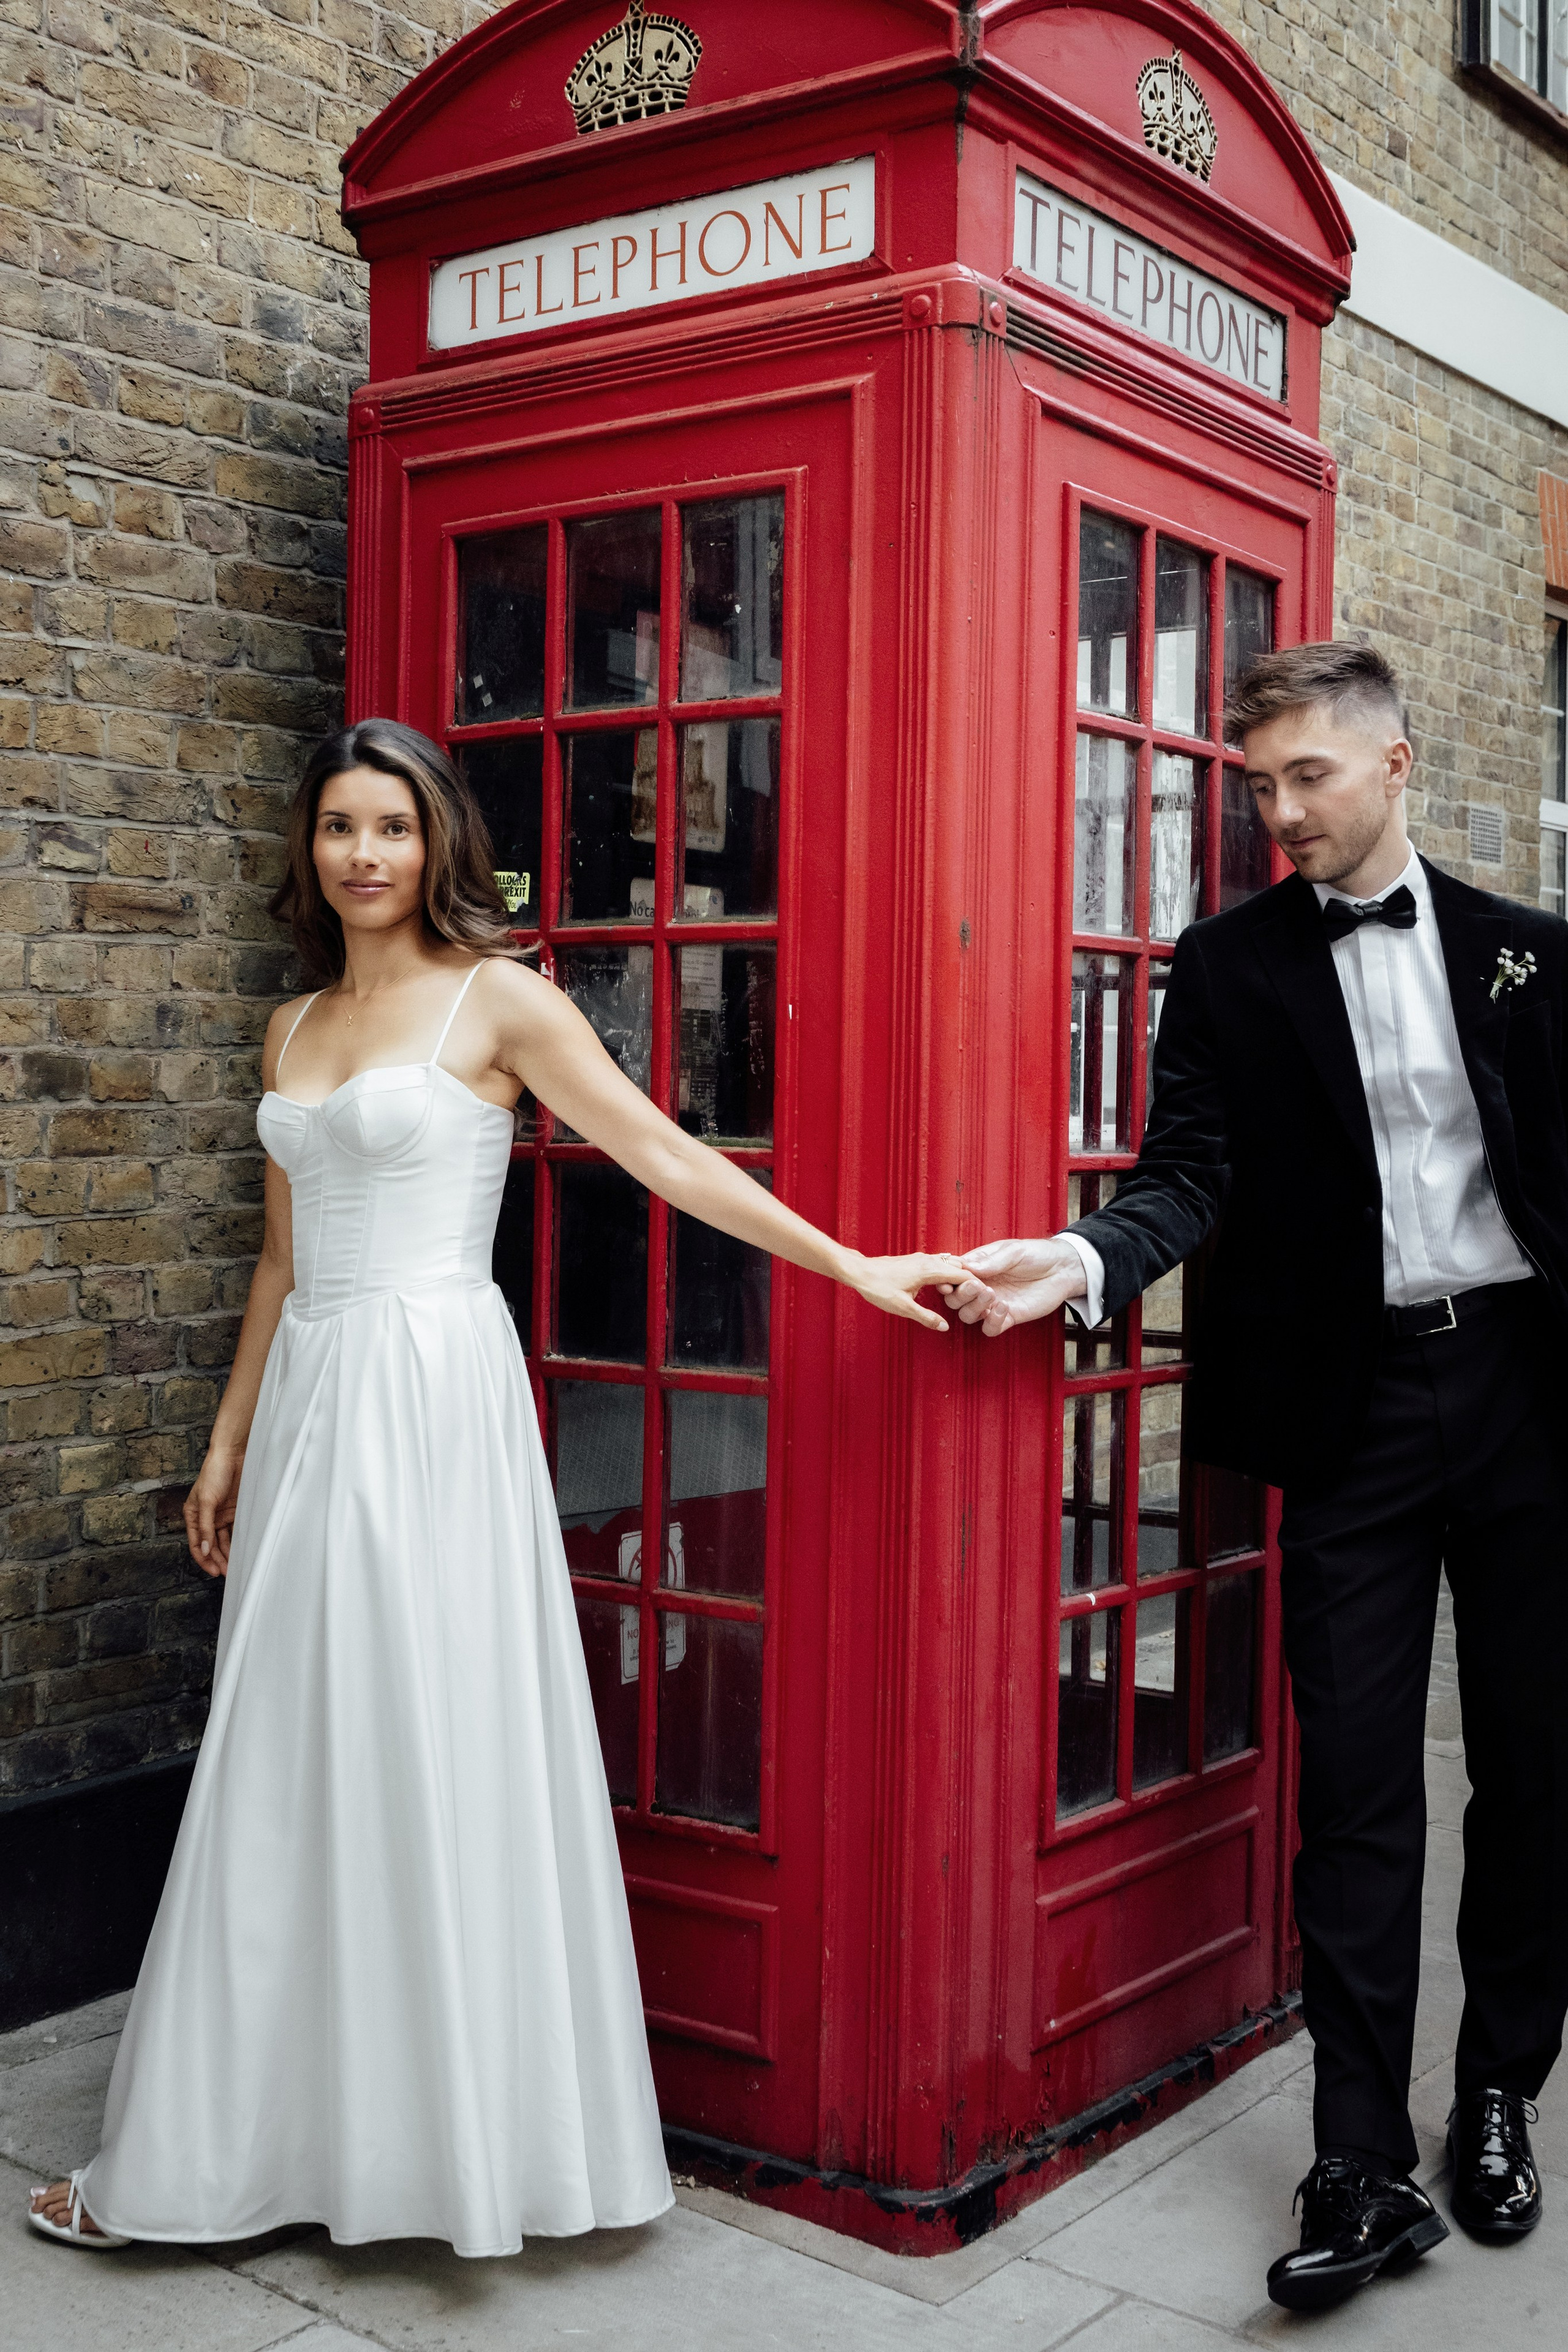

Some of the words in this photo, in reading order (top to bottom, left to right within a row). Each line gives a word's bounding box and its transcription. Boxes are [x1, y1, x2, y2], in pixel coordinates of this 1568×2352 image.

[459, 183, 852, 330] TELEPHONE
[1018, 187, 1273, 391] TELEPHONE
[627, 1628, 639, 1640] NO
